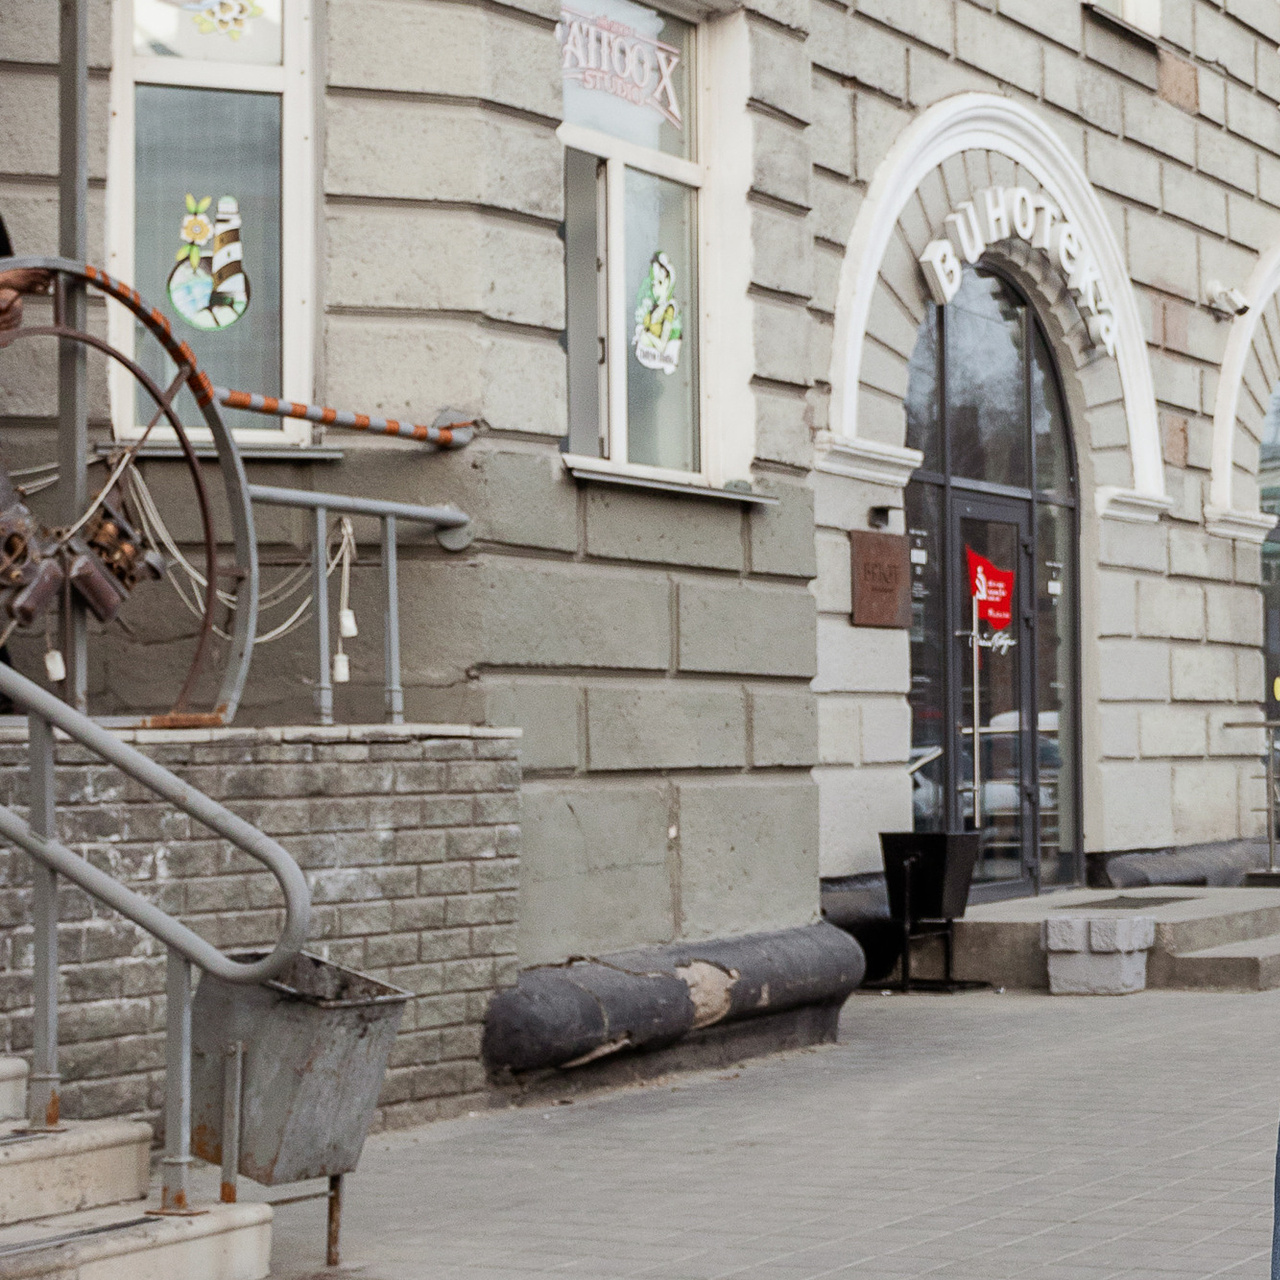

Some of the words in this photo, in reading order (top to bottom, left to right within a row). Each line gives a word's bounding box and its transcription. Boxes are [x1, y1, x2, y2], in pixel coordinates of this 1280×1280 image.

[561, 11, 649, 87] ATTOO
[653, 50, 682, 121] X
[582, 69, 643, 106] STUDIO
